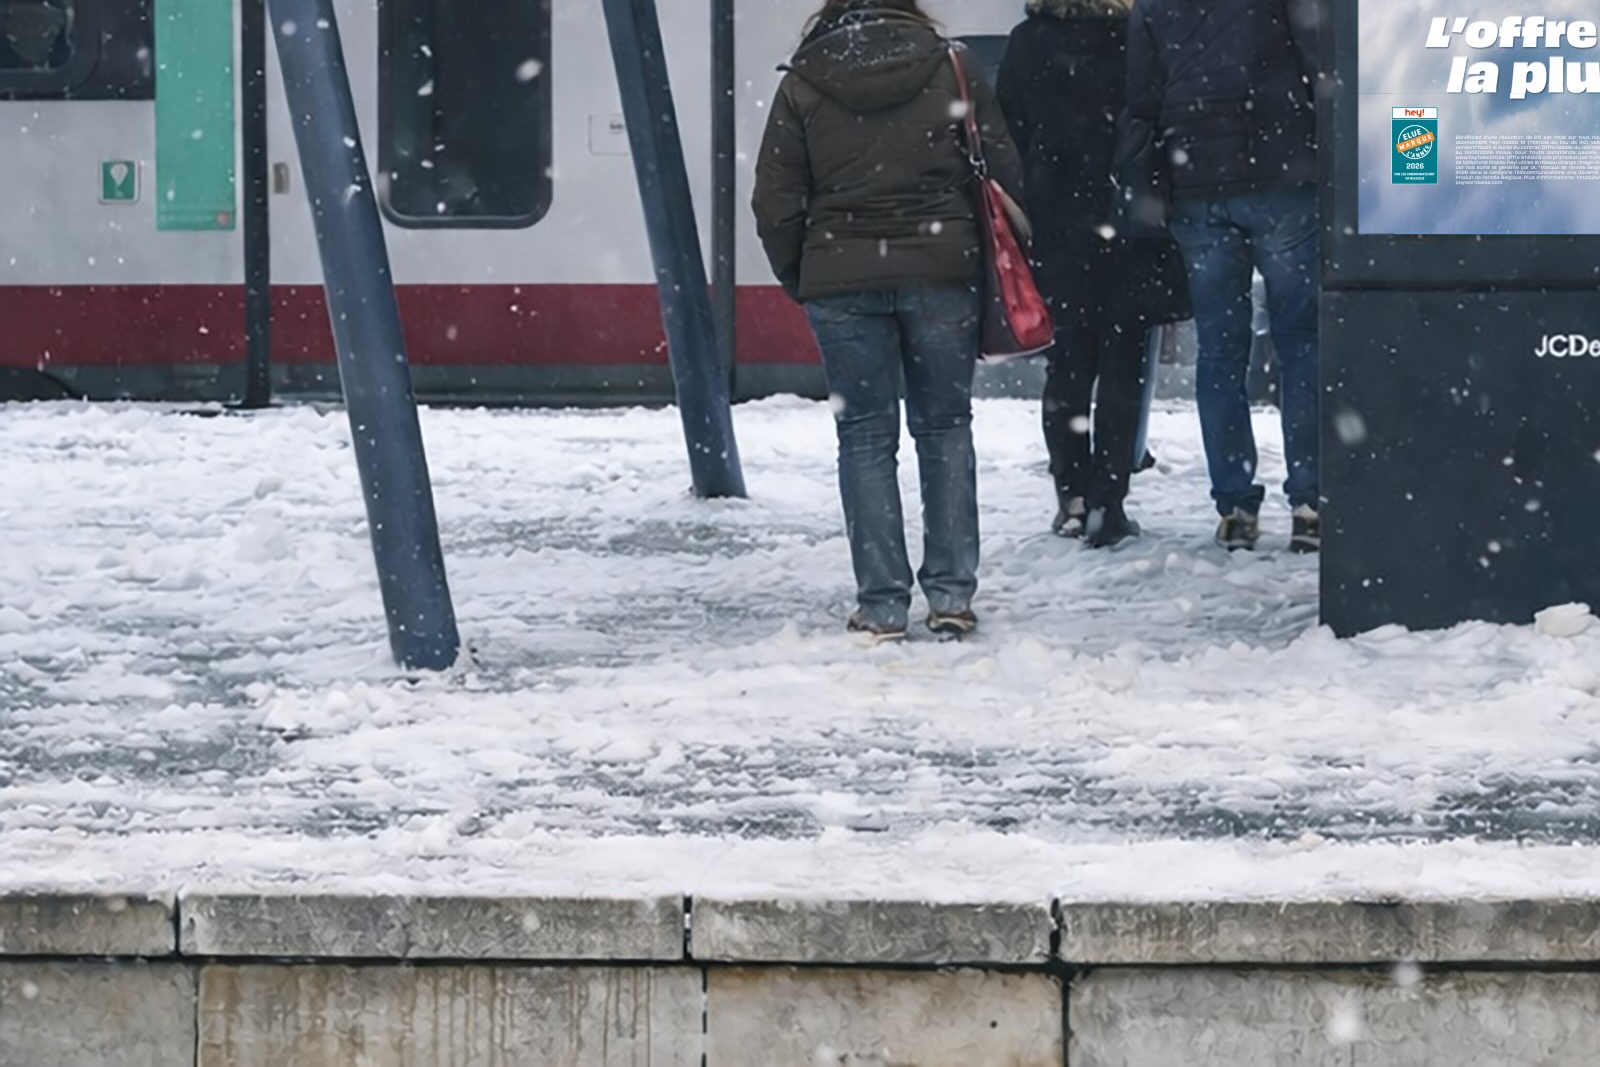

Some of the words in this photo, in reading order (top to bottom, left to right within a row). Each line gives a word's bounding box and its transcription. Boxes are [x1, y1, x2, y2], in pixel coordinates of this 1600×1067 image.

[1425, 16, 1598, 48] L'offre
[1446, 56, 1499, 93] la
[1405, 109, 1424, 118] hey!
[1399, 134, 1432, 150] MARQUE
